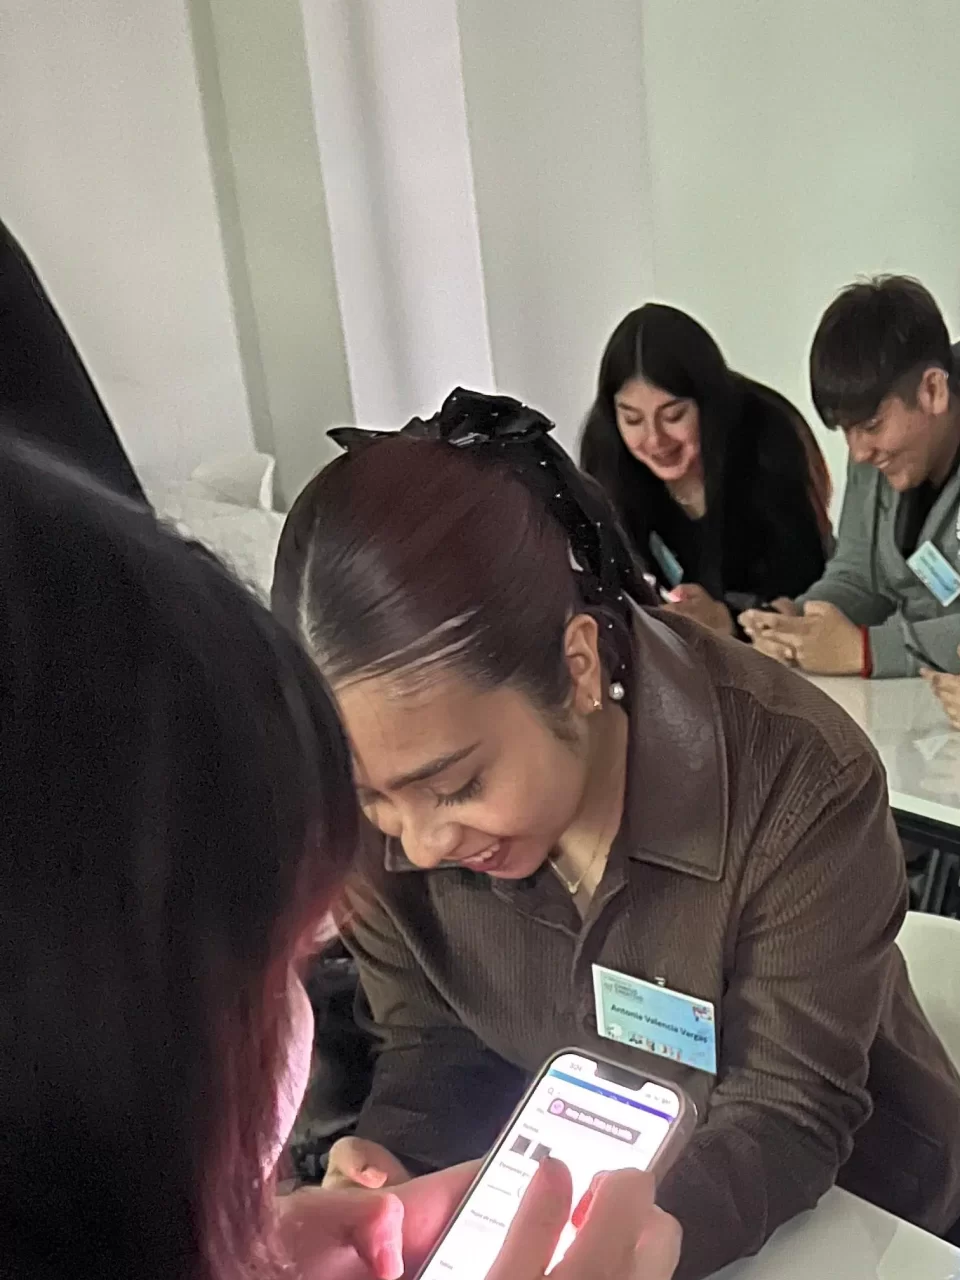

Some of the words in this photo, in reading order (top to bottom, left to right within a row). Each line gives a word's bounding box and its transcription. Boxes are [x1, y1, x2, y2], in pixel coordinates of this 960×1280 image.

[611, 1004, 643, 1021] Antonia
[645, 1015, 679, 1033] Valencia
[680, 1026, 708, 1044] Vargas
